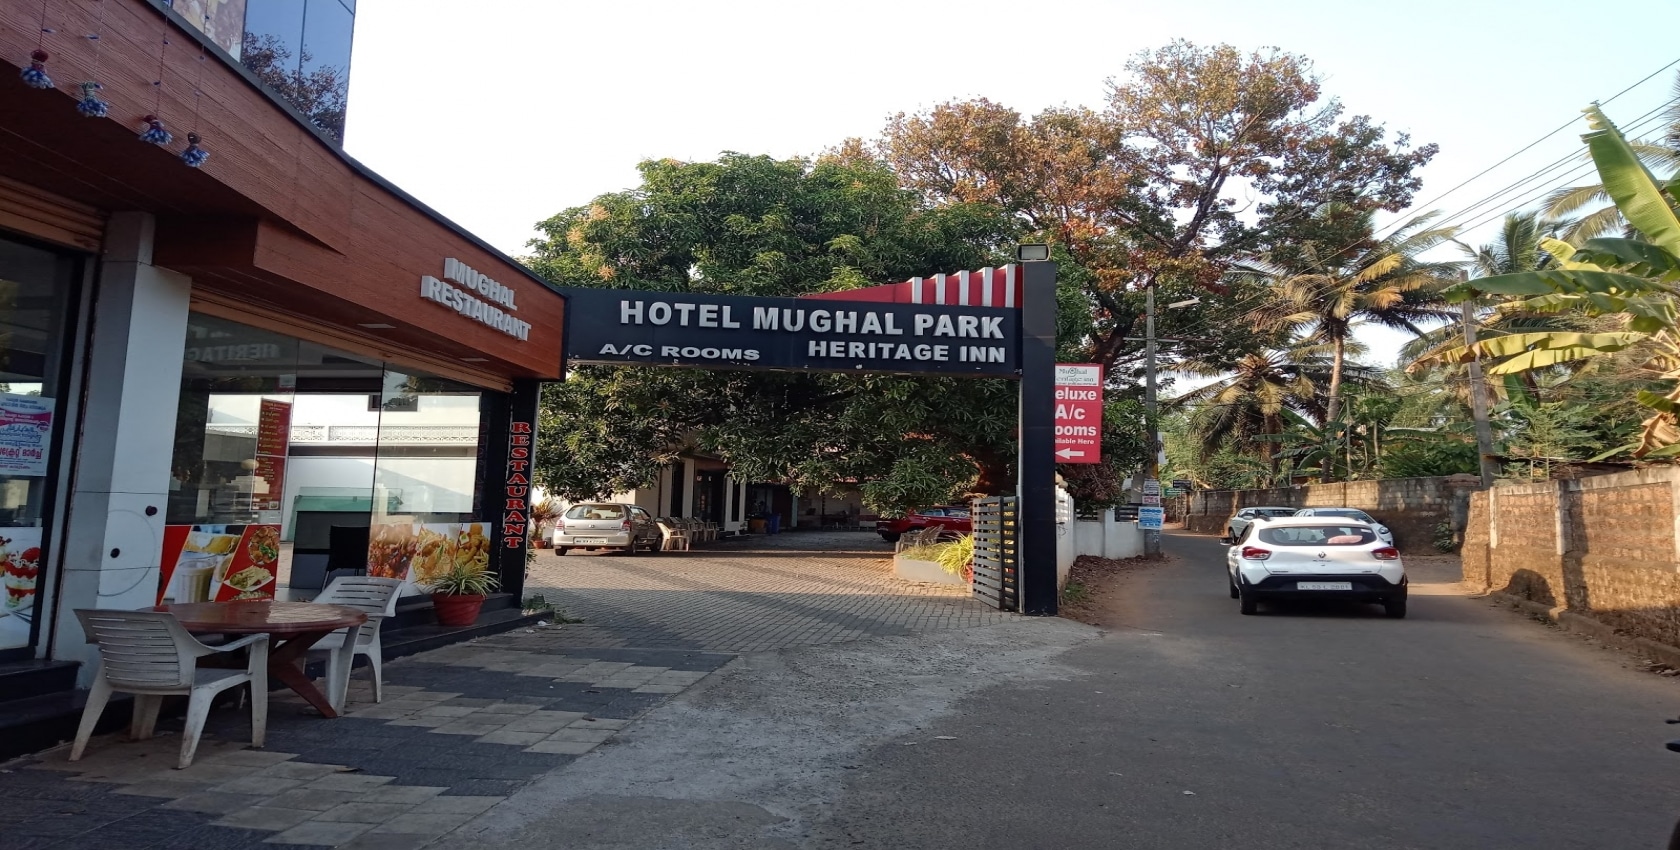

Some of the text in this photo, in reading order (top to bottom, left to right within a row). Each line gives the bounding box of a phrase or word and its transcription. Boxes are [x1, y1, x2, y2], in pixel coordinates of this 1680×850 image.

[444, 258, 517, 311] MUGHAL
[421, 276, 532, 341] RESTAURANT
[620, 300, 1005, 339] HOTEL MUGHAL PARK
[599, 343, 760, 361] A/C ROOMS
[808, 340, 1006, 363] HERITAGE INN
[1055, 387, 1097, 400] eluxe
[1055, 403, 1086, 420] A/c
[1055, 425, 1097, 436] ooms
[504, 421, 532, 549] RESTAURANT
